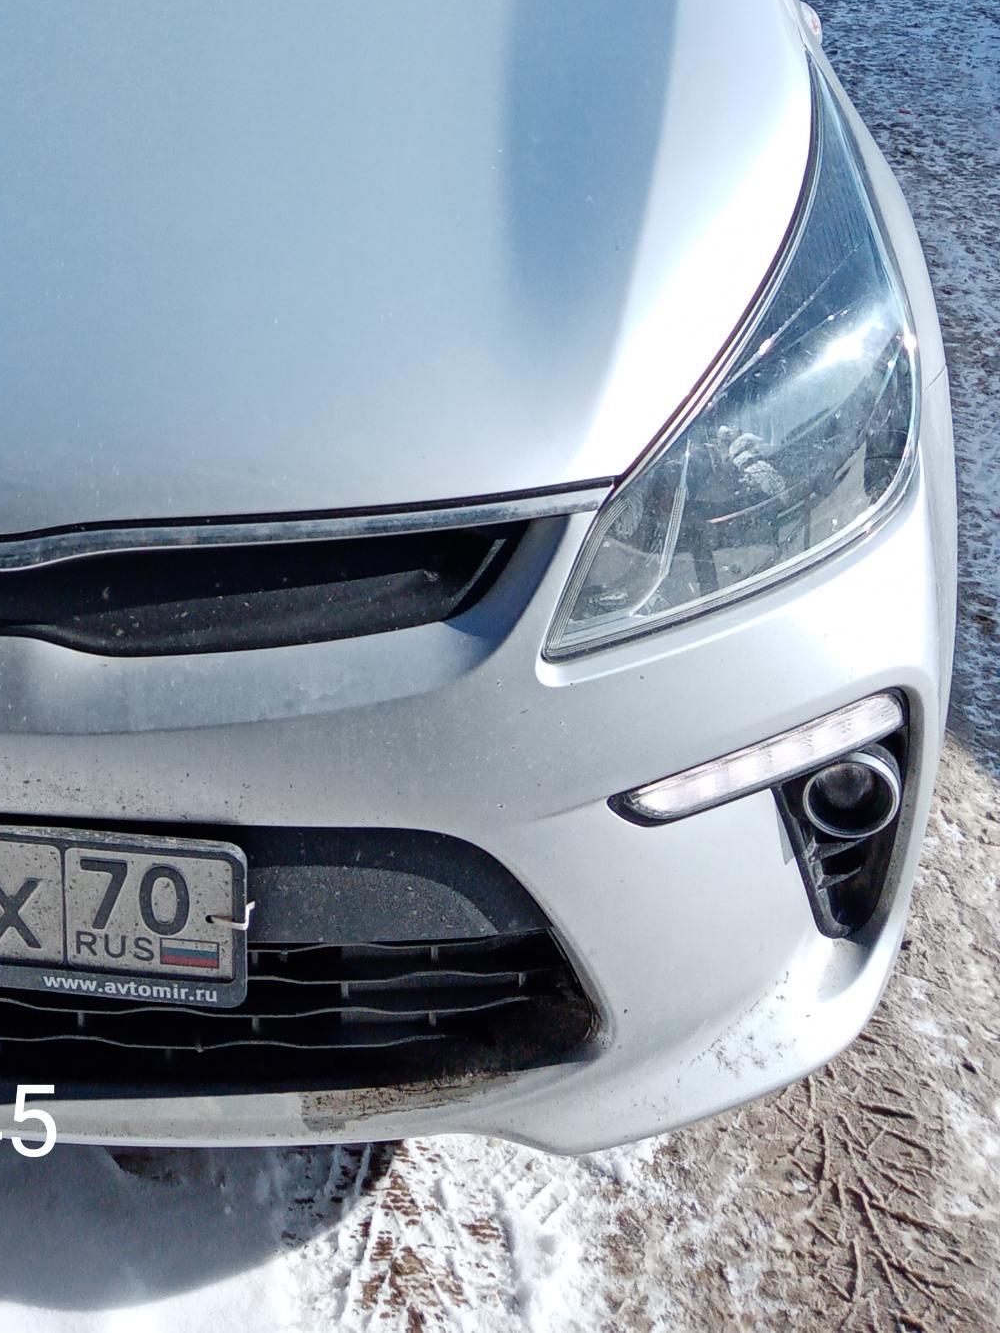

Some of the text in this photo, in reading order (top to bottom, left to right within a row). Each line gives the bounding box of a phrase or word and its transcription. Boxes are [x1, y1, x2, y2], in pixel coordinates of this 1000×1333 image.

[80, 857, 190, 936] 70
[76, 931, 155, 961] RUS
[43, 975, 218, 1003] www.avtomir.ru
